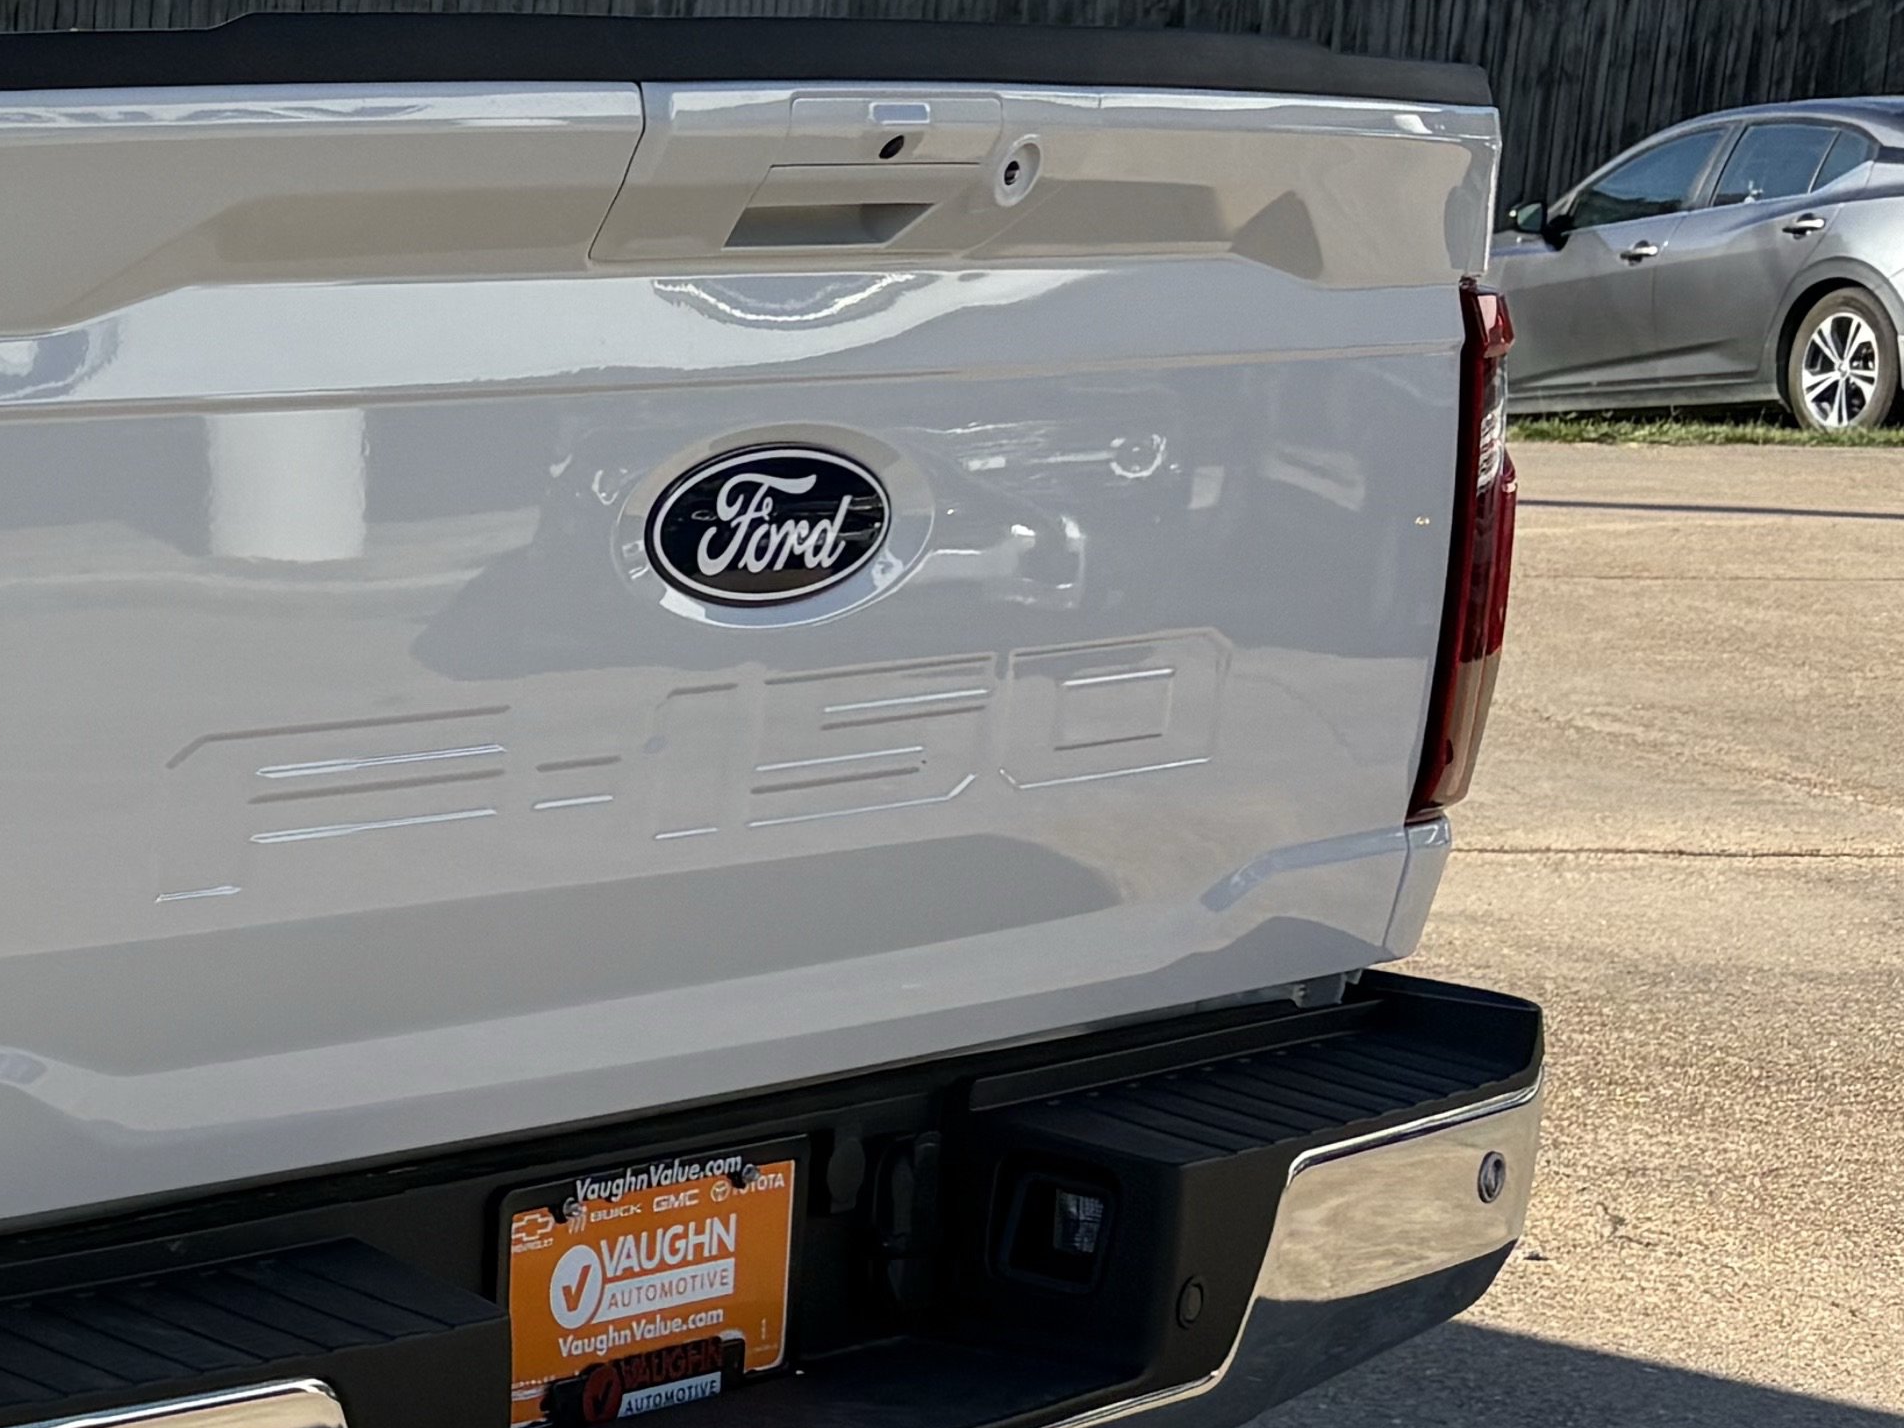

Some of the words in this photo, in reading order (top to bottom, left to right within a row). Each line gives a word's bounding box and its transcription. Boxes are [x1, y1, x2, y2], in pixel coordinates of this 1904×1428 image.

[696, 472, 853, 577] Ford
[576, 1155, 742, 1203] VaughnValue.com
[589, 1202, 643, 1223] BUICK
[652, 1189, 700, 1213] GMC
[600, 1213, 737, 1278] VAUGHN
[607, 1267, 730, 1311] AUTOMOTIVE
[558, 1308, 724, 1357] VaughnValue.com
[624, 1380, 718, 1415] AUTOMOTIVE
